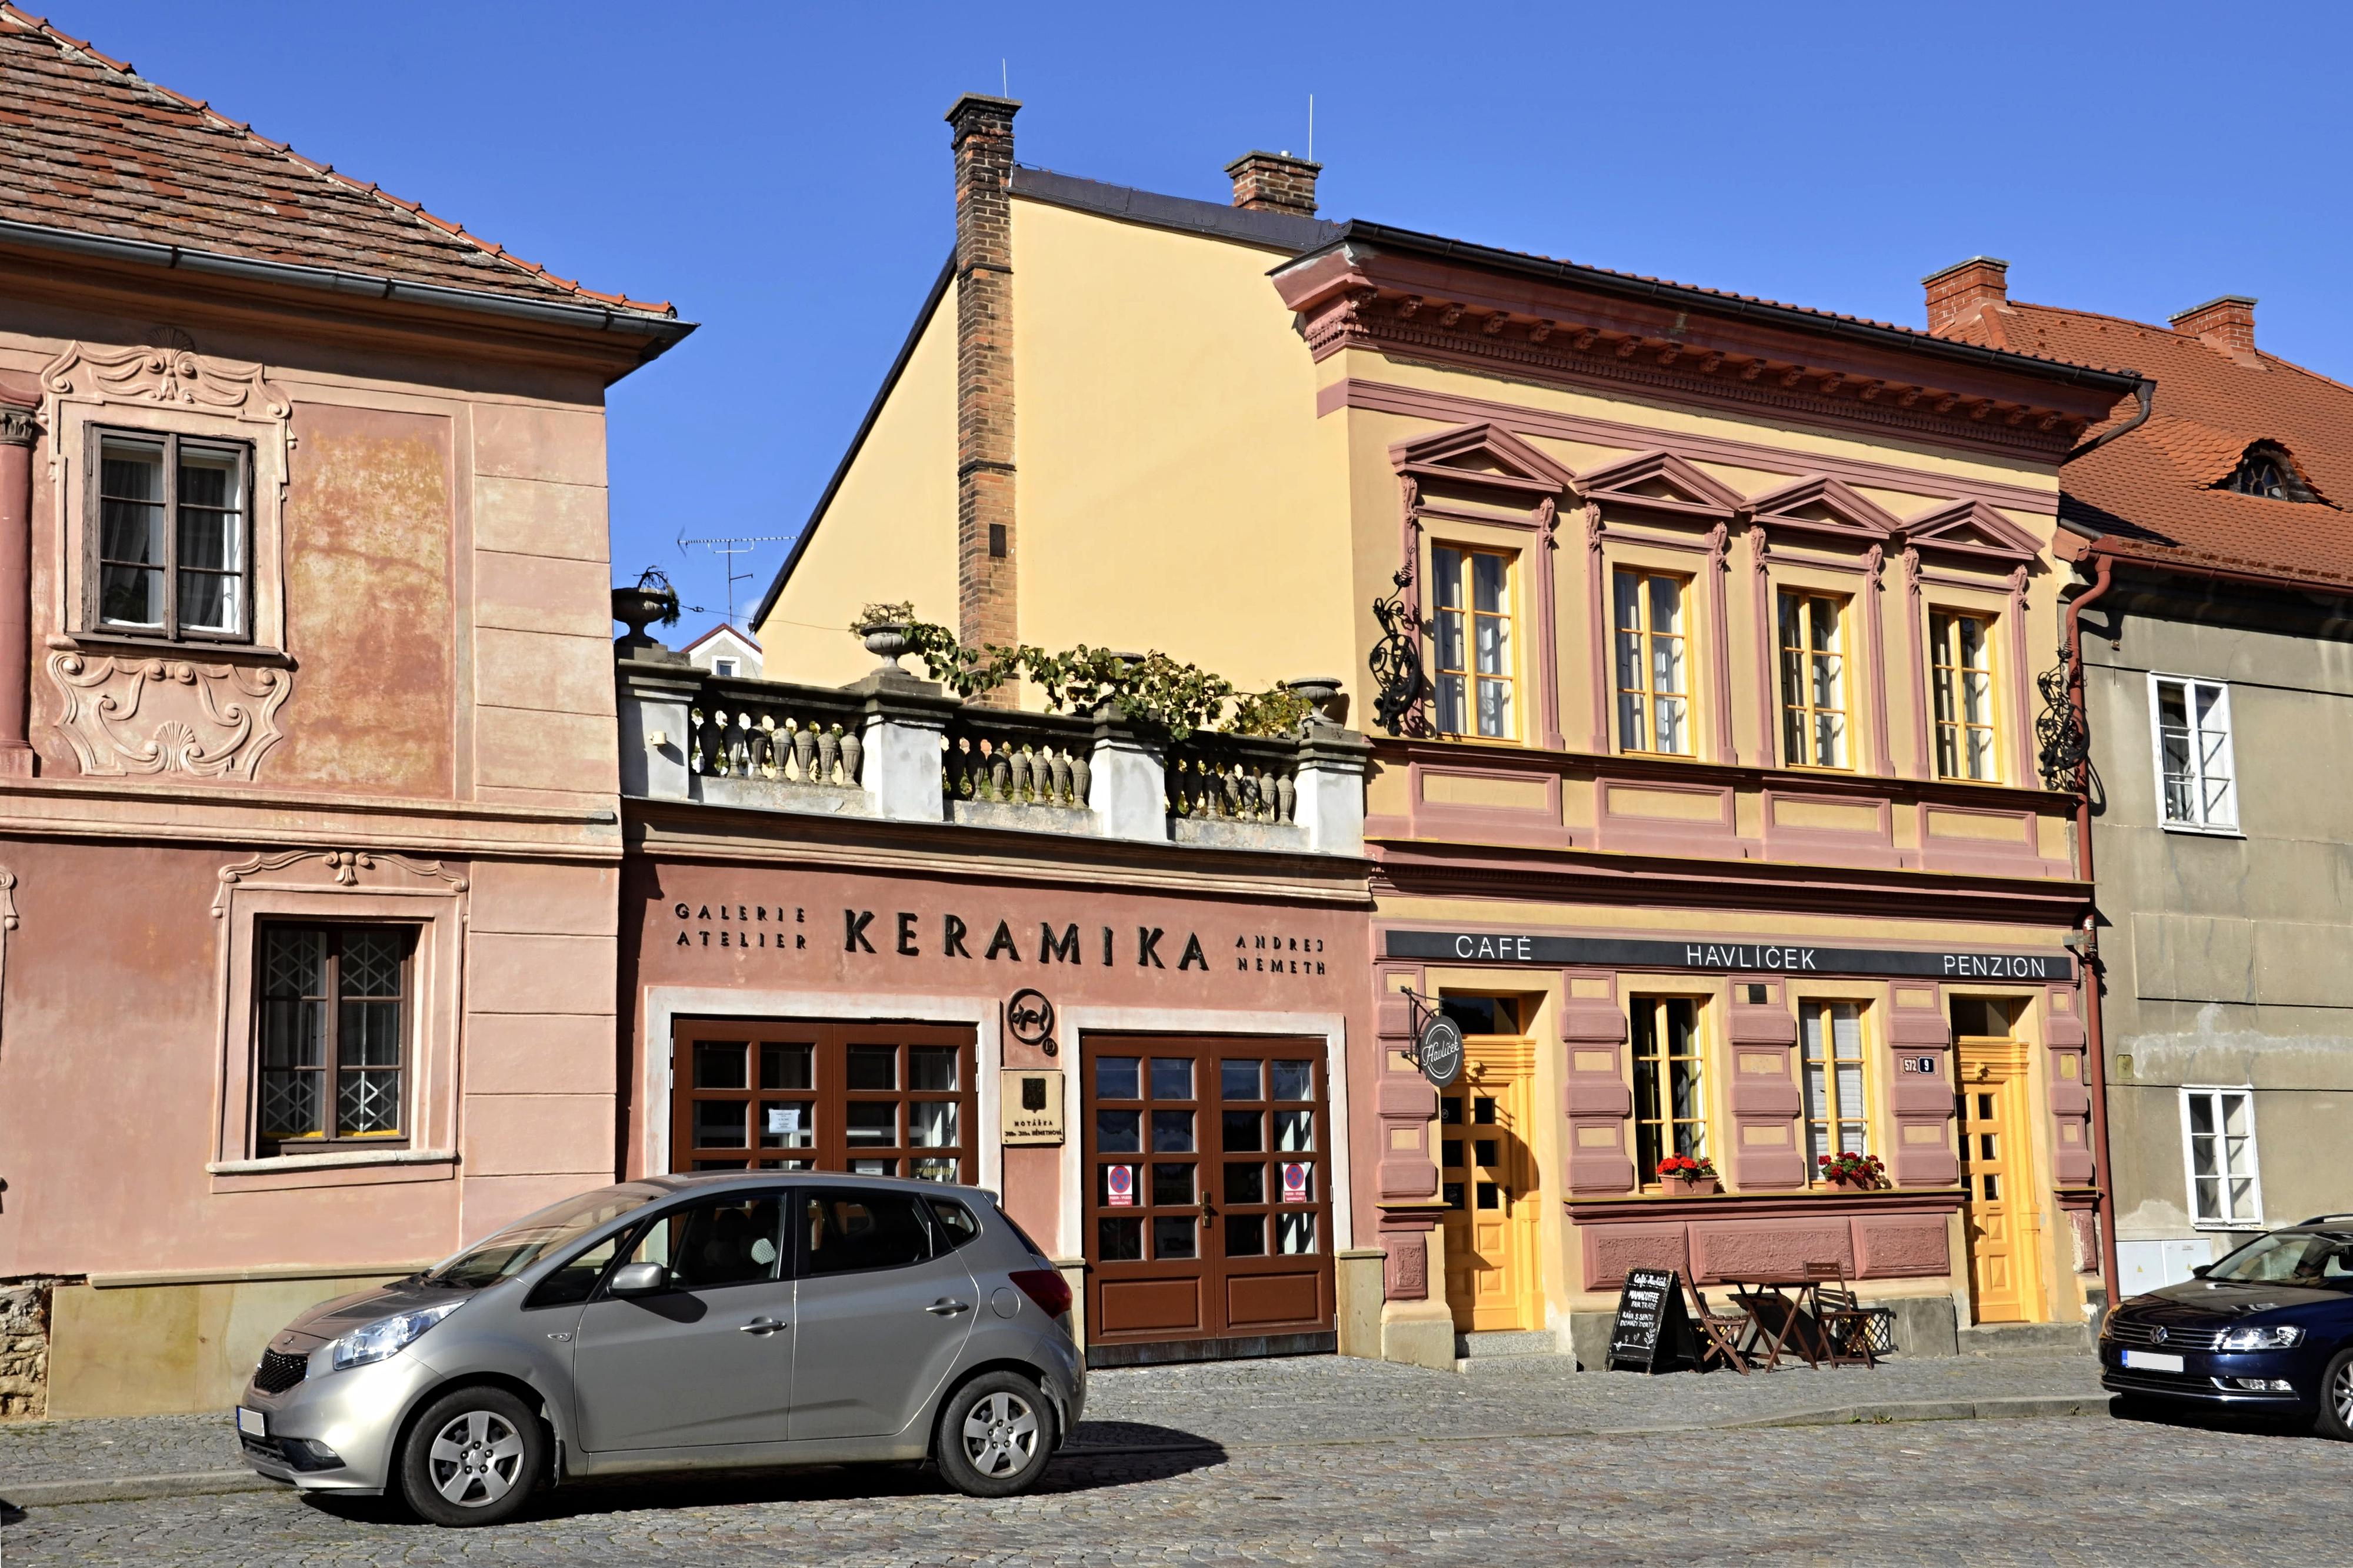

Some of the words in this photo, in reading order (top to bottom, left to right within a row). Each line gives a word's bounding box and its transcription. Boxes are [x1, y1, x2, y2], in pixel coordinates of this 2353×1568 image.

[675, 902, 805, 923] GALERIE
[676, 930, 806, 949] ATELIER
[844, 909, 1209, 971] KERAMIKA
[1235, 935, 1323, 952] ANDREJ
[1455, 935, 1532, 960] CAFÉ
[1687, 945, 1816, 969] HAVLÍČEK
[1944, 955, 2045, 978] PENZION
[1904, 1059, 1917, 1071] 572
[1924, 1059, 1929, 1071] 9
[1631, 1300, 1641, 1309] FAIR
[1641, 1302, 1657, 1310] TRADE
